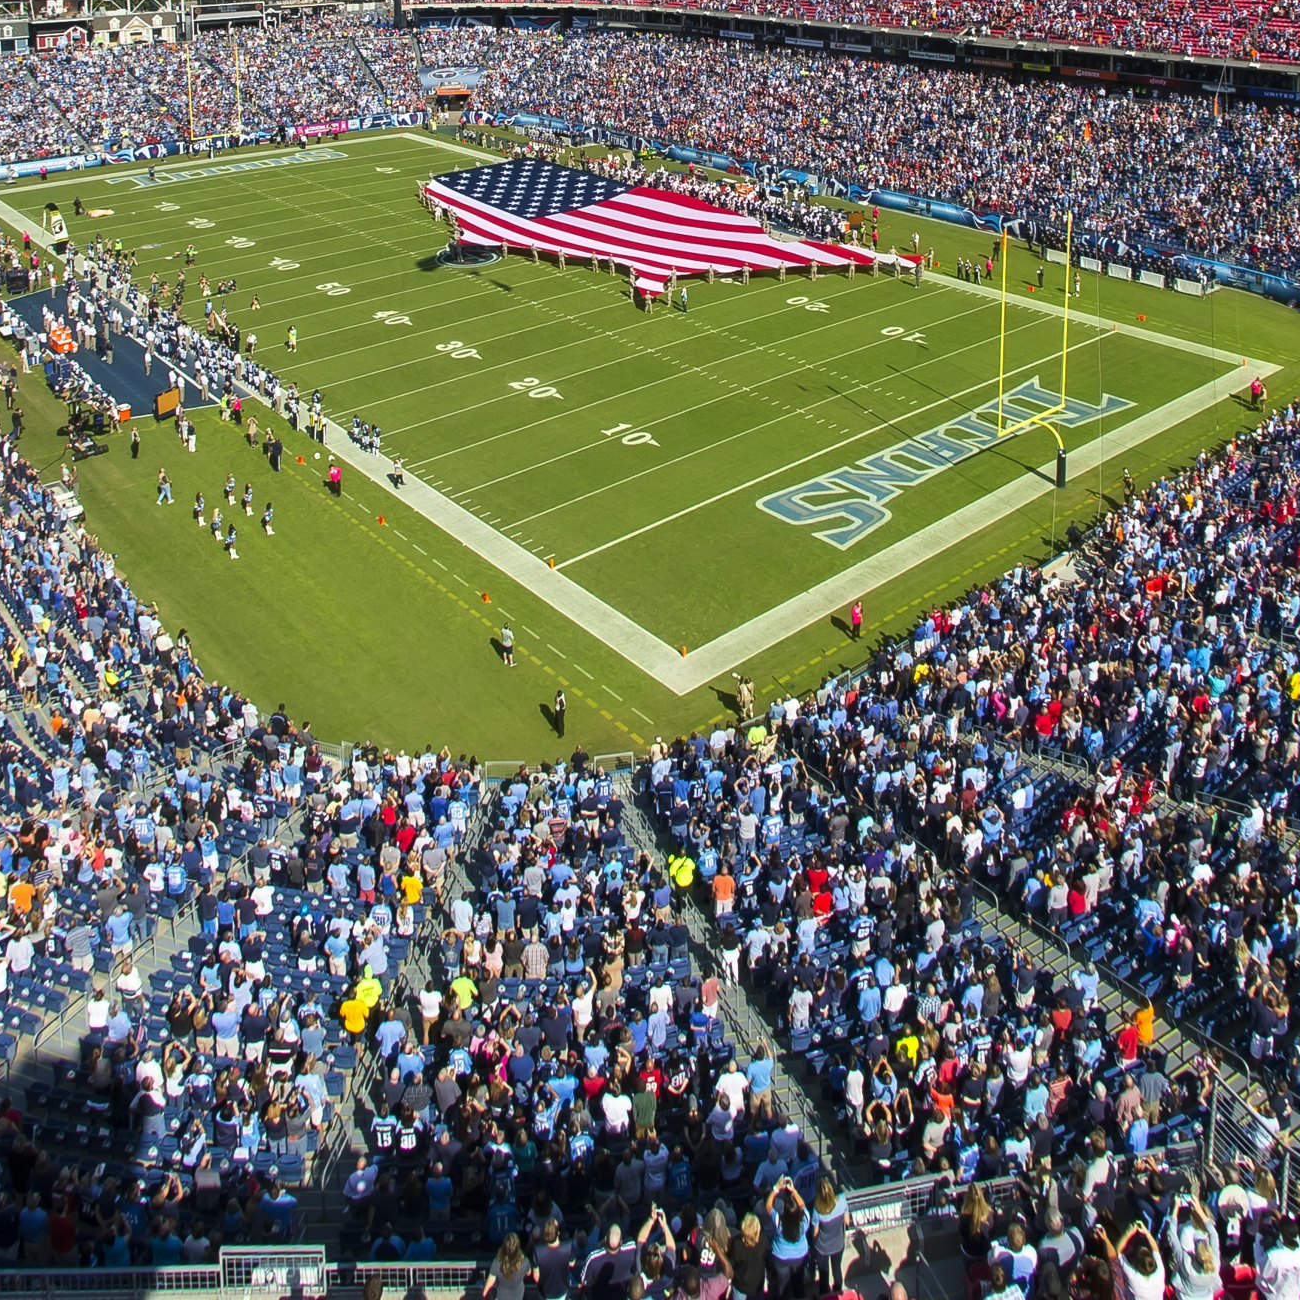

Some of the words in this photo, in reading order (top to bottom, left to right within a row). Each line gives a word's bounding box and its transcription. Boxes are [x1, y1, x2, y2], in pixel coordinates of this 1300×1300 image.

[1149, 77, 1167, 86] xfinity
[1264, 91, 1295, 99] UNITED
[104, 148, 349, 190] TITANS
[154, 201, 181, 212] 10
[186, 218, 216, 228] 20
[224, 236, 256, 248] 30
[268, 256, 300, 271] 40
[316, 282, 351, 296] 50
[786, 296, 830, 312] 20
[372, 310, 410, 325] 40
[880, 326, 926, 343] 10
[435, 340, 478, 359] 30
[508, 378, 557, 398] 20
[600, 422, 652, 446] 10
[755, 375, 1138, 551] TITANS
[600, 786, 608, 796] 10
[768, 825, 780, 835] 34
[705, 858, 714, 868] 10
[376, 1131, 392, 1148] 15
[700, 1249, 716, 1266] 99
